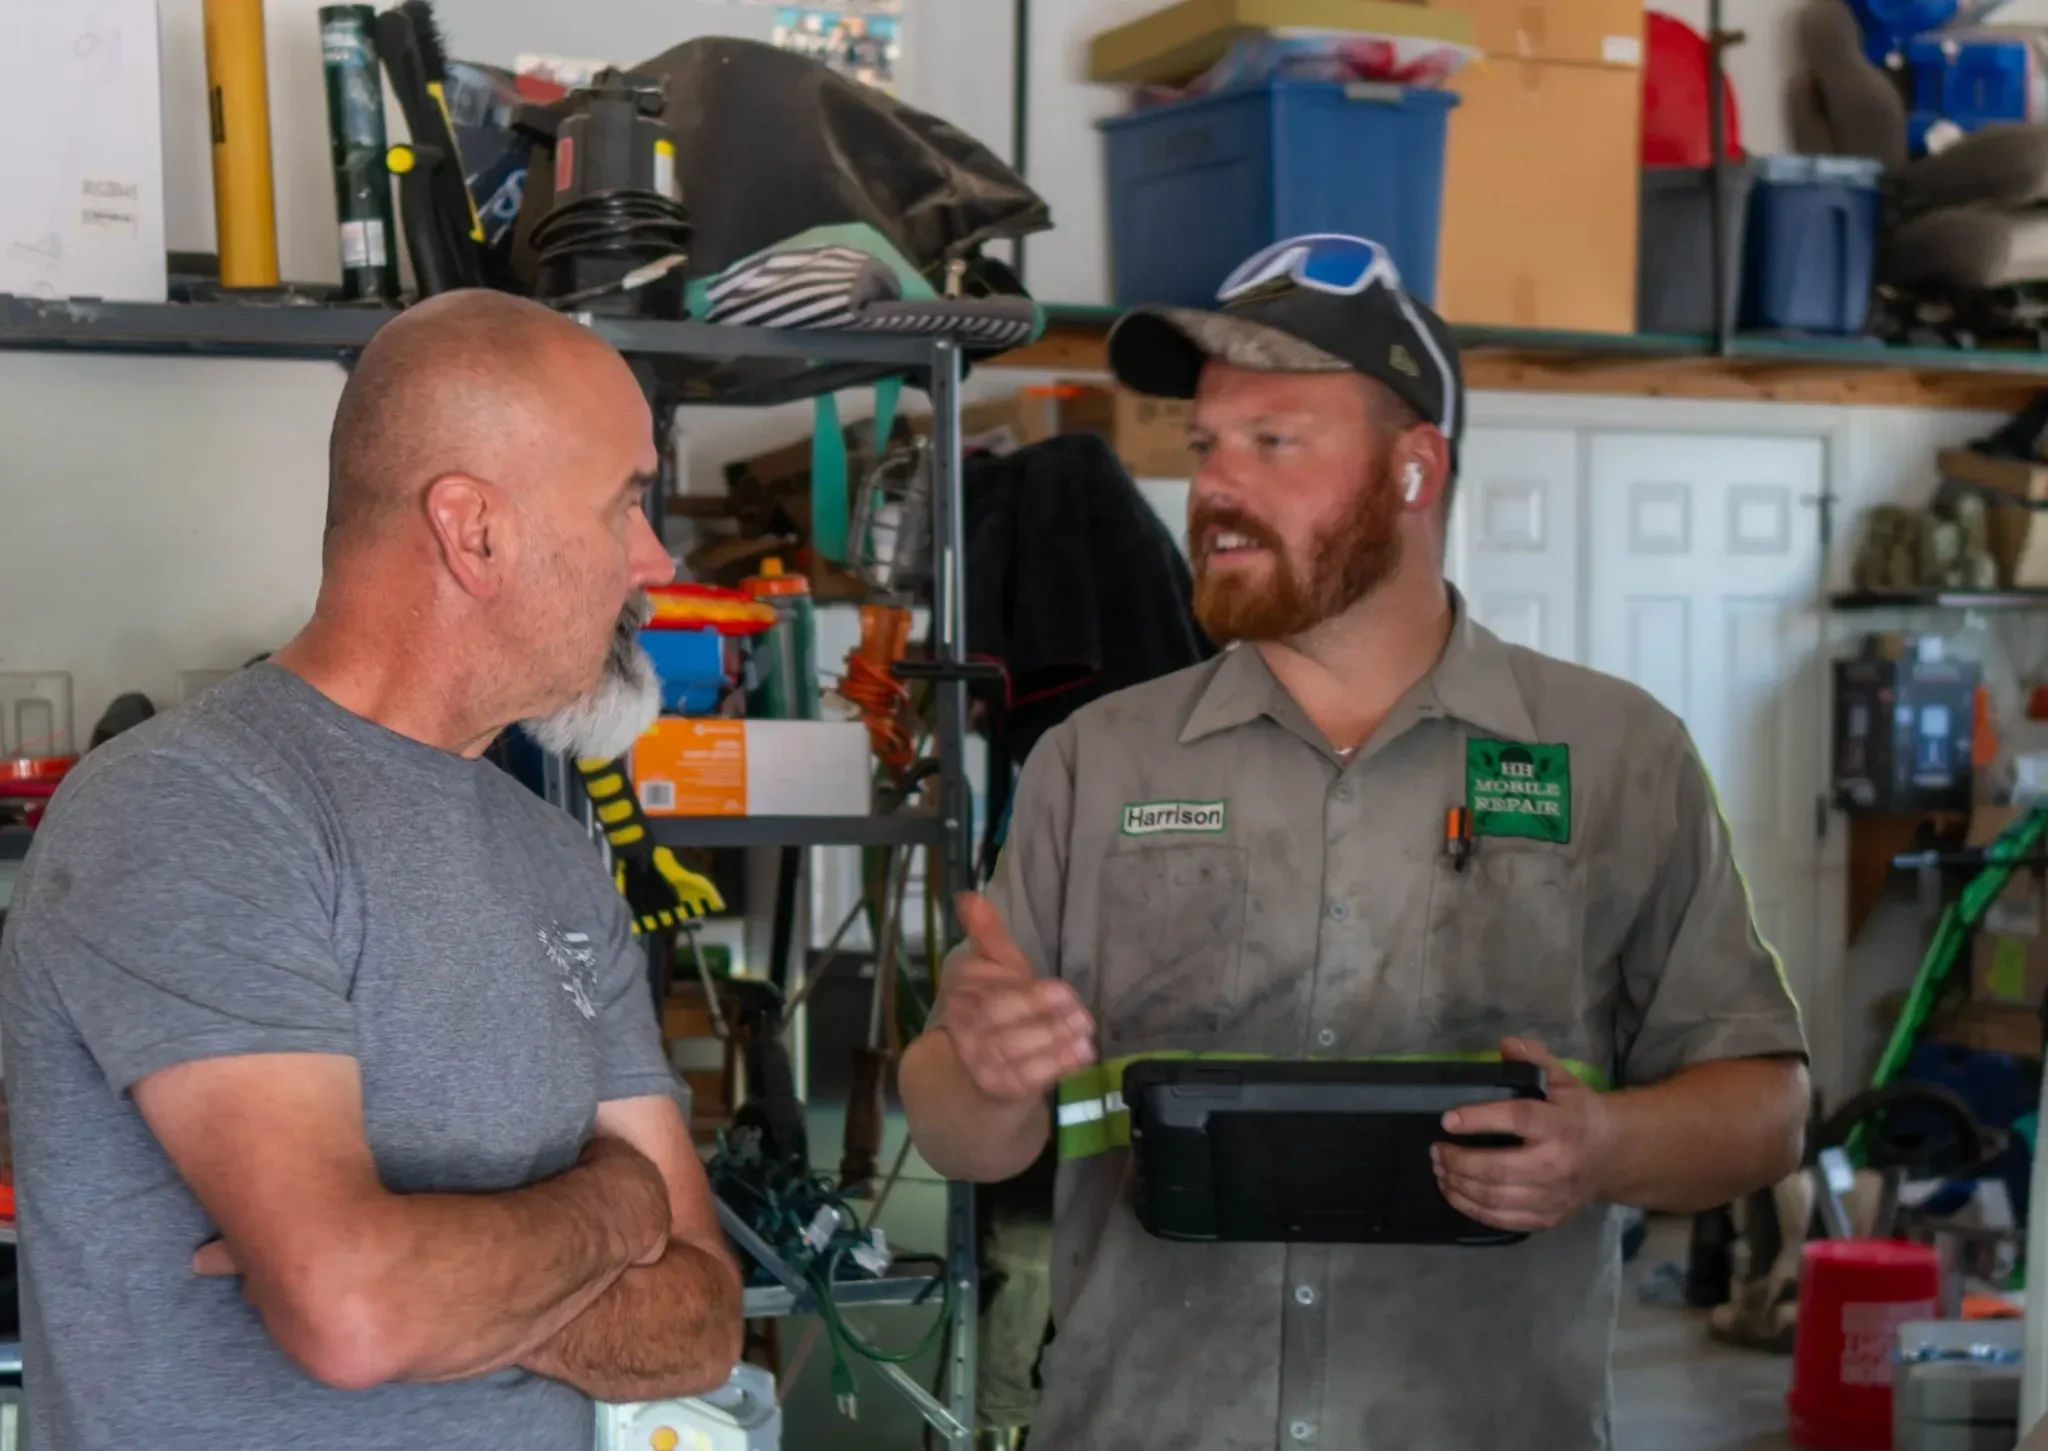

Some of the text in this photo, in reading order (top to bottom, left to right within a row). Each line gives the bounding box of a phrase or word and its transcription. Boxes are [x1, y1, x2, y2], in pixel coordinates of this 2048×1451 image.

[1500, 762, 1534, 777] HH
[1474, 779, 1561, 797] MOBILE
[1474, 796, 1561, 816] REPAIR
[1128, 804, 1220, 828] Harrison
